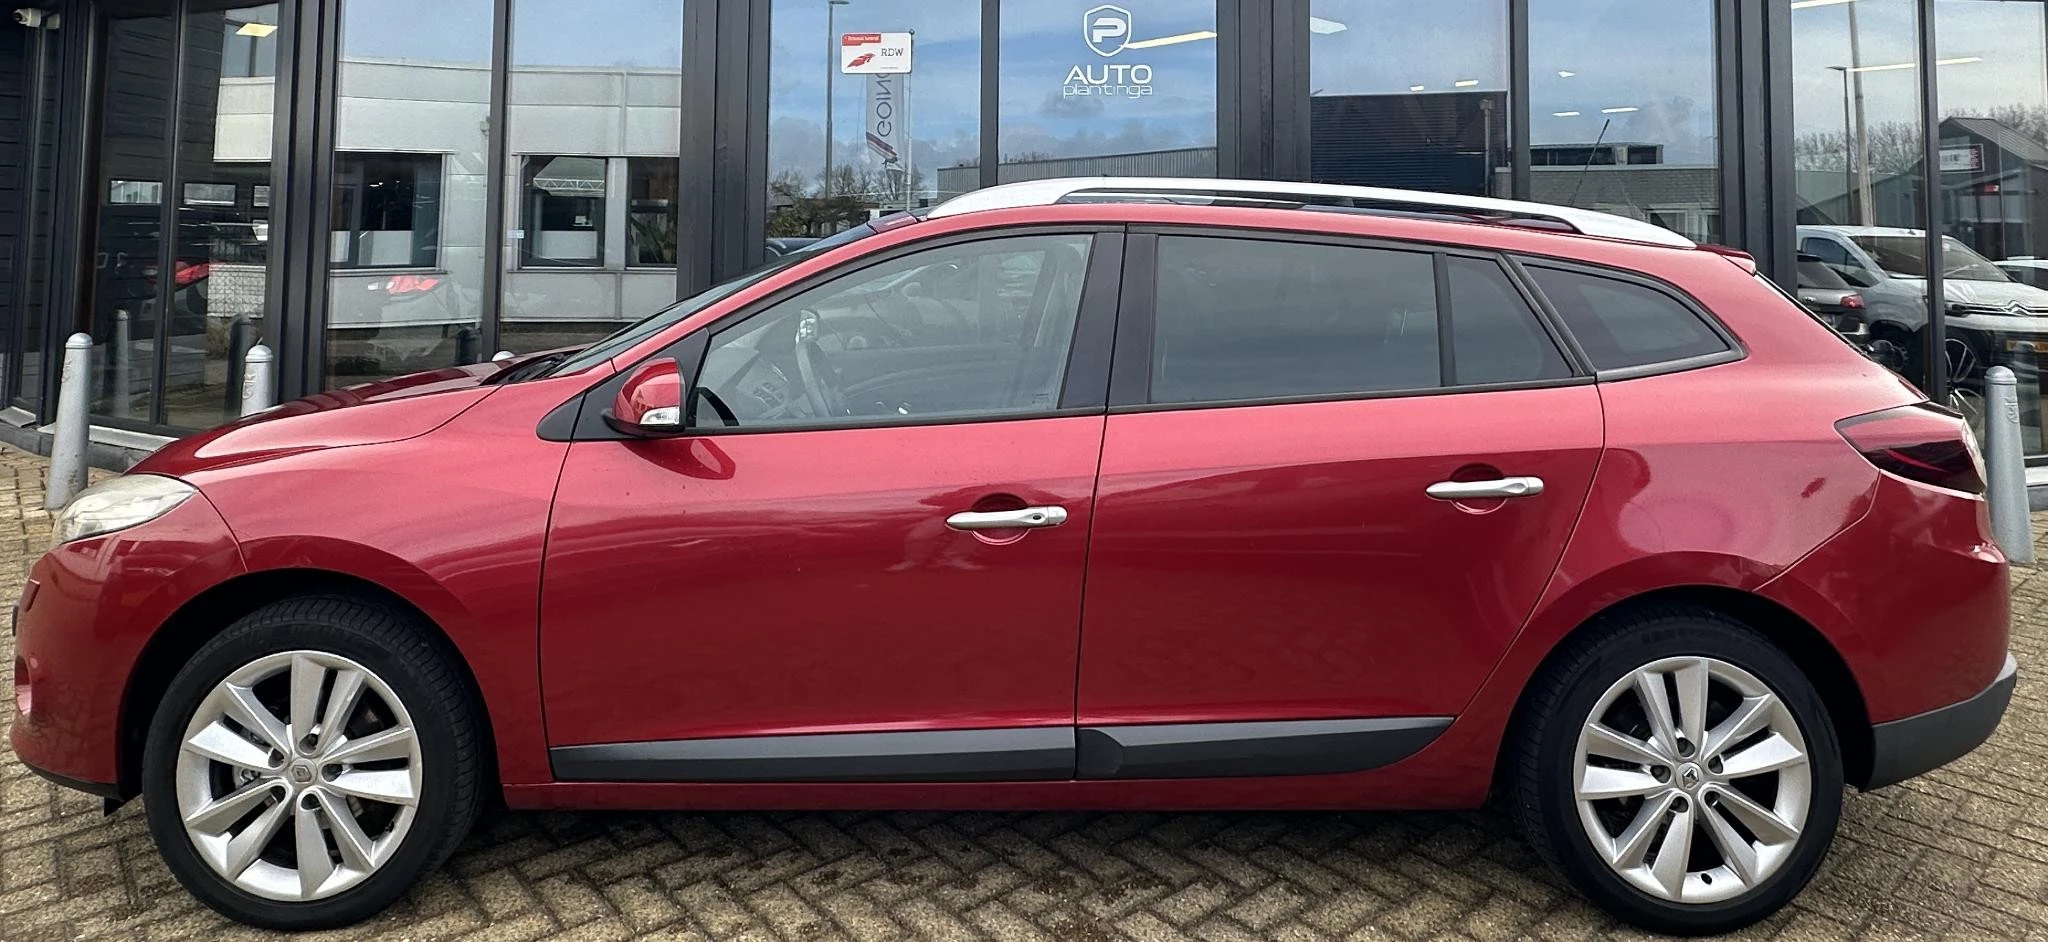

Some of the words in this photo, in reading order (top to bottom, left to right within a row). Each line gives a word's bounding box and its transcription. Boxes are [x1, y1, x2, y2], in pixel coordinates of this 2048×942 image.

[1092, 17, 1127, 43] P
[881, 48, 904, 57] RDW
[1063, 64, 1153, 85] AUTO
[1063, 84, 1153, 99] plantinga
